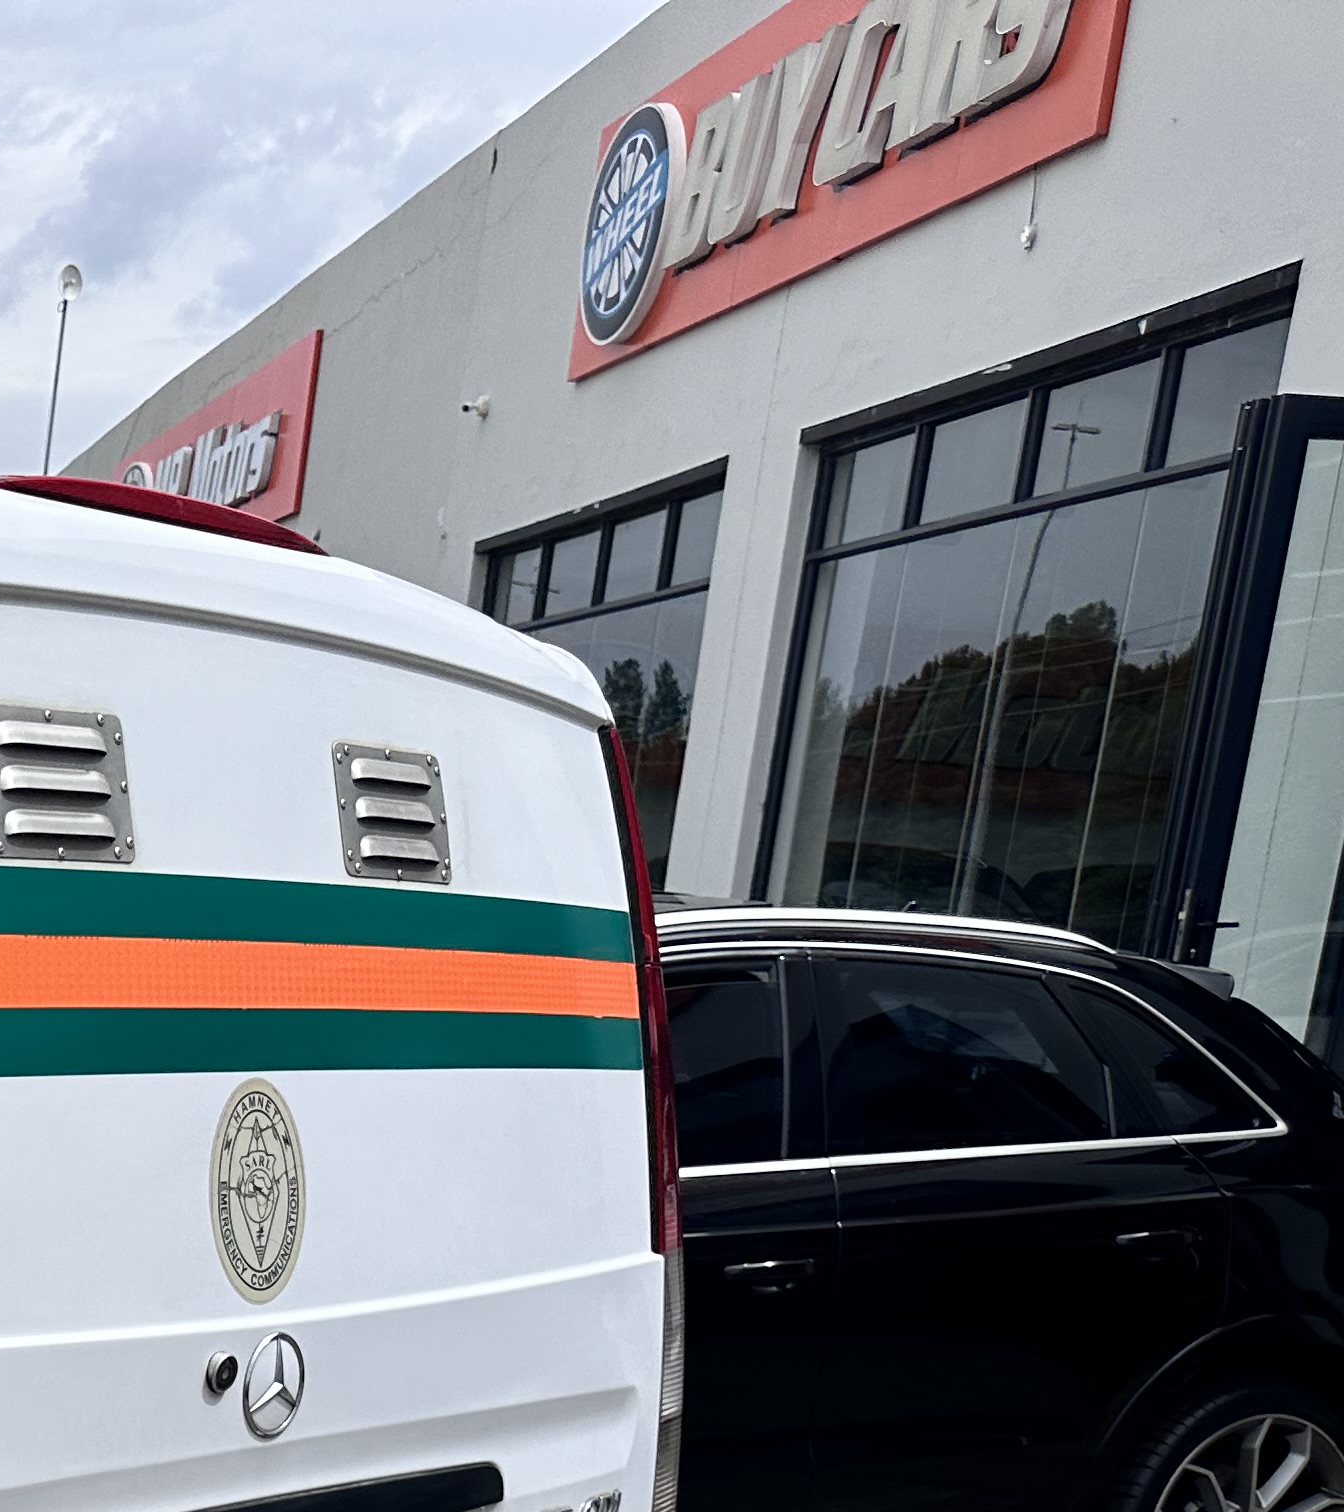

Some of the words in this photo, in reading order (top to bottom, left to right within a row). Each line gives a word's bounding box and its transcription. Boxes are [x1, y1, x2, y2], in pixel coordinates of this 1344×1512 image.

[584, 161, 664, 285] WHEEL
[232, 1095, 282, 1123] HAMNET
[244, 1155, 272, 1172] SARL
[218, 1181, 248, 1276] EMERGENCY
[250, 1176, 298, 1288] COMMUNICATIONS
